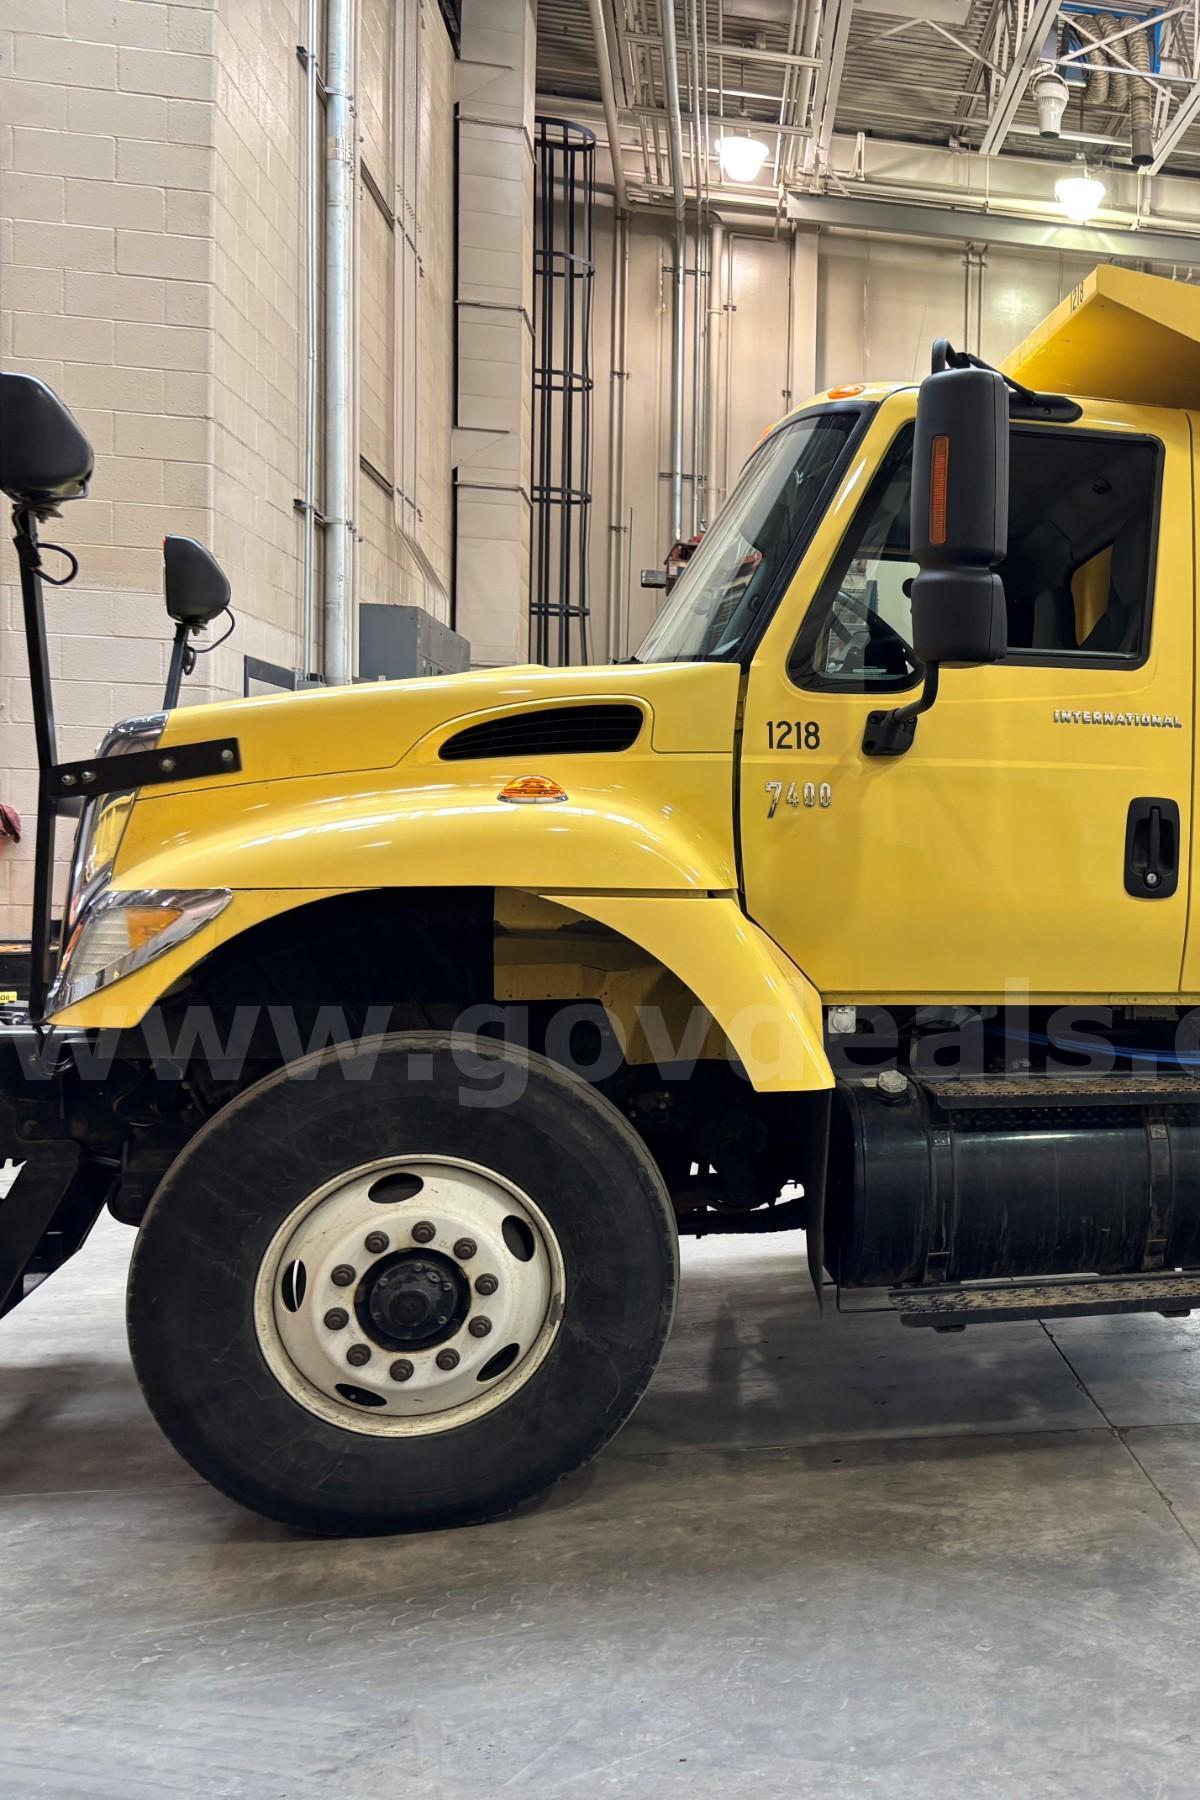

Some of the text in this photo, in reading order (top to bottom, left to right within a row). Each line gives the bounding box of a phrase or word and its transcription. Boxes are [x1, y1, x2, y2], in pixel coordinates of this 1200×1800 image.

[1053, 709, 1183, 729] INTERNATIONAL
[766, 720, 821, 750] 1218
[765, 781, 832, 819] 7400
